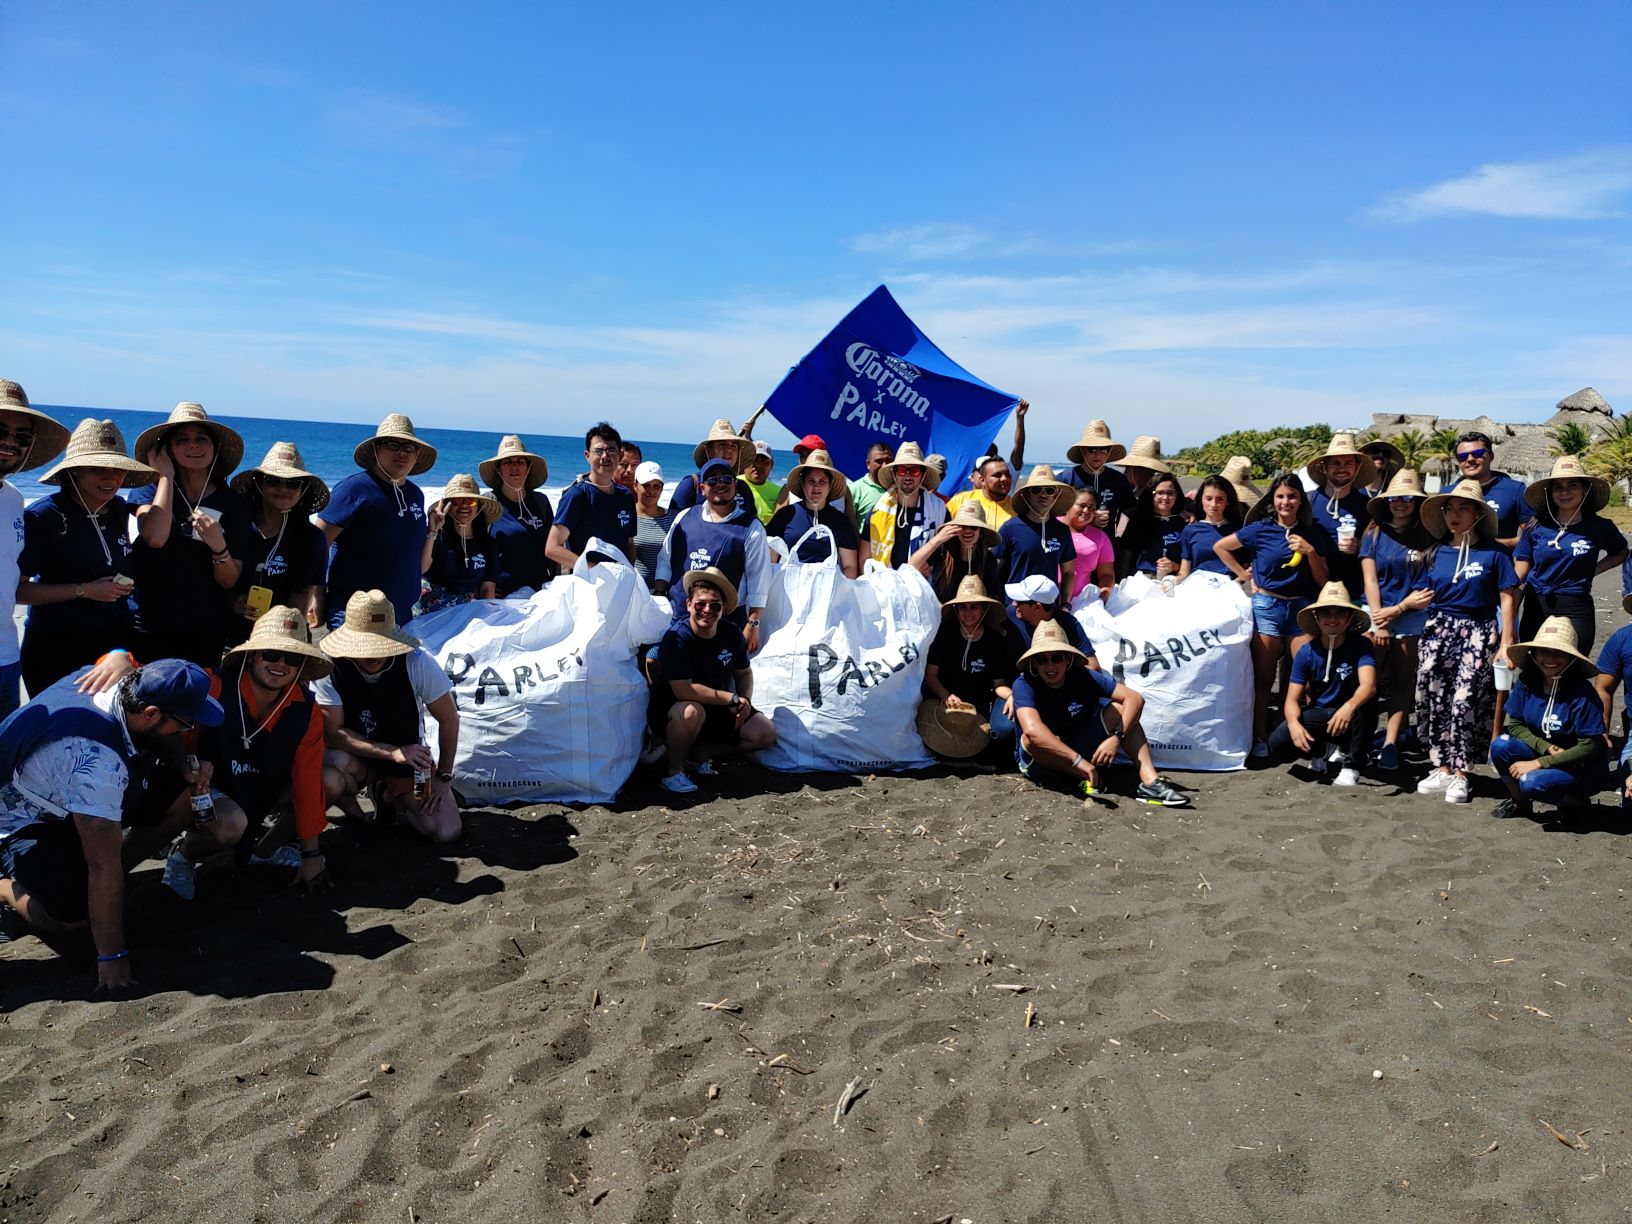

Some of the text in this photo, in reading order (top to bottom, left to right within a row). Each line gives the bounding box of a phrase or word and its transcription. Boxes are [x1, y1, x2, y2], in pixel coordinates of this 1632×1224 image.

[830, 381, 907, 439] PARLEY
[845, 341, 931, 418] Corona
[443, 647, 584, 711] PARLEY
[807, 641, 920, 710] PARLEY
[1112, 628, 1223, 686] PARLEY
